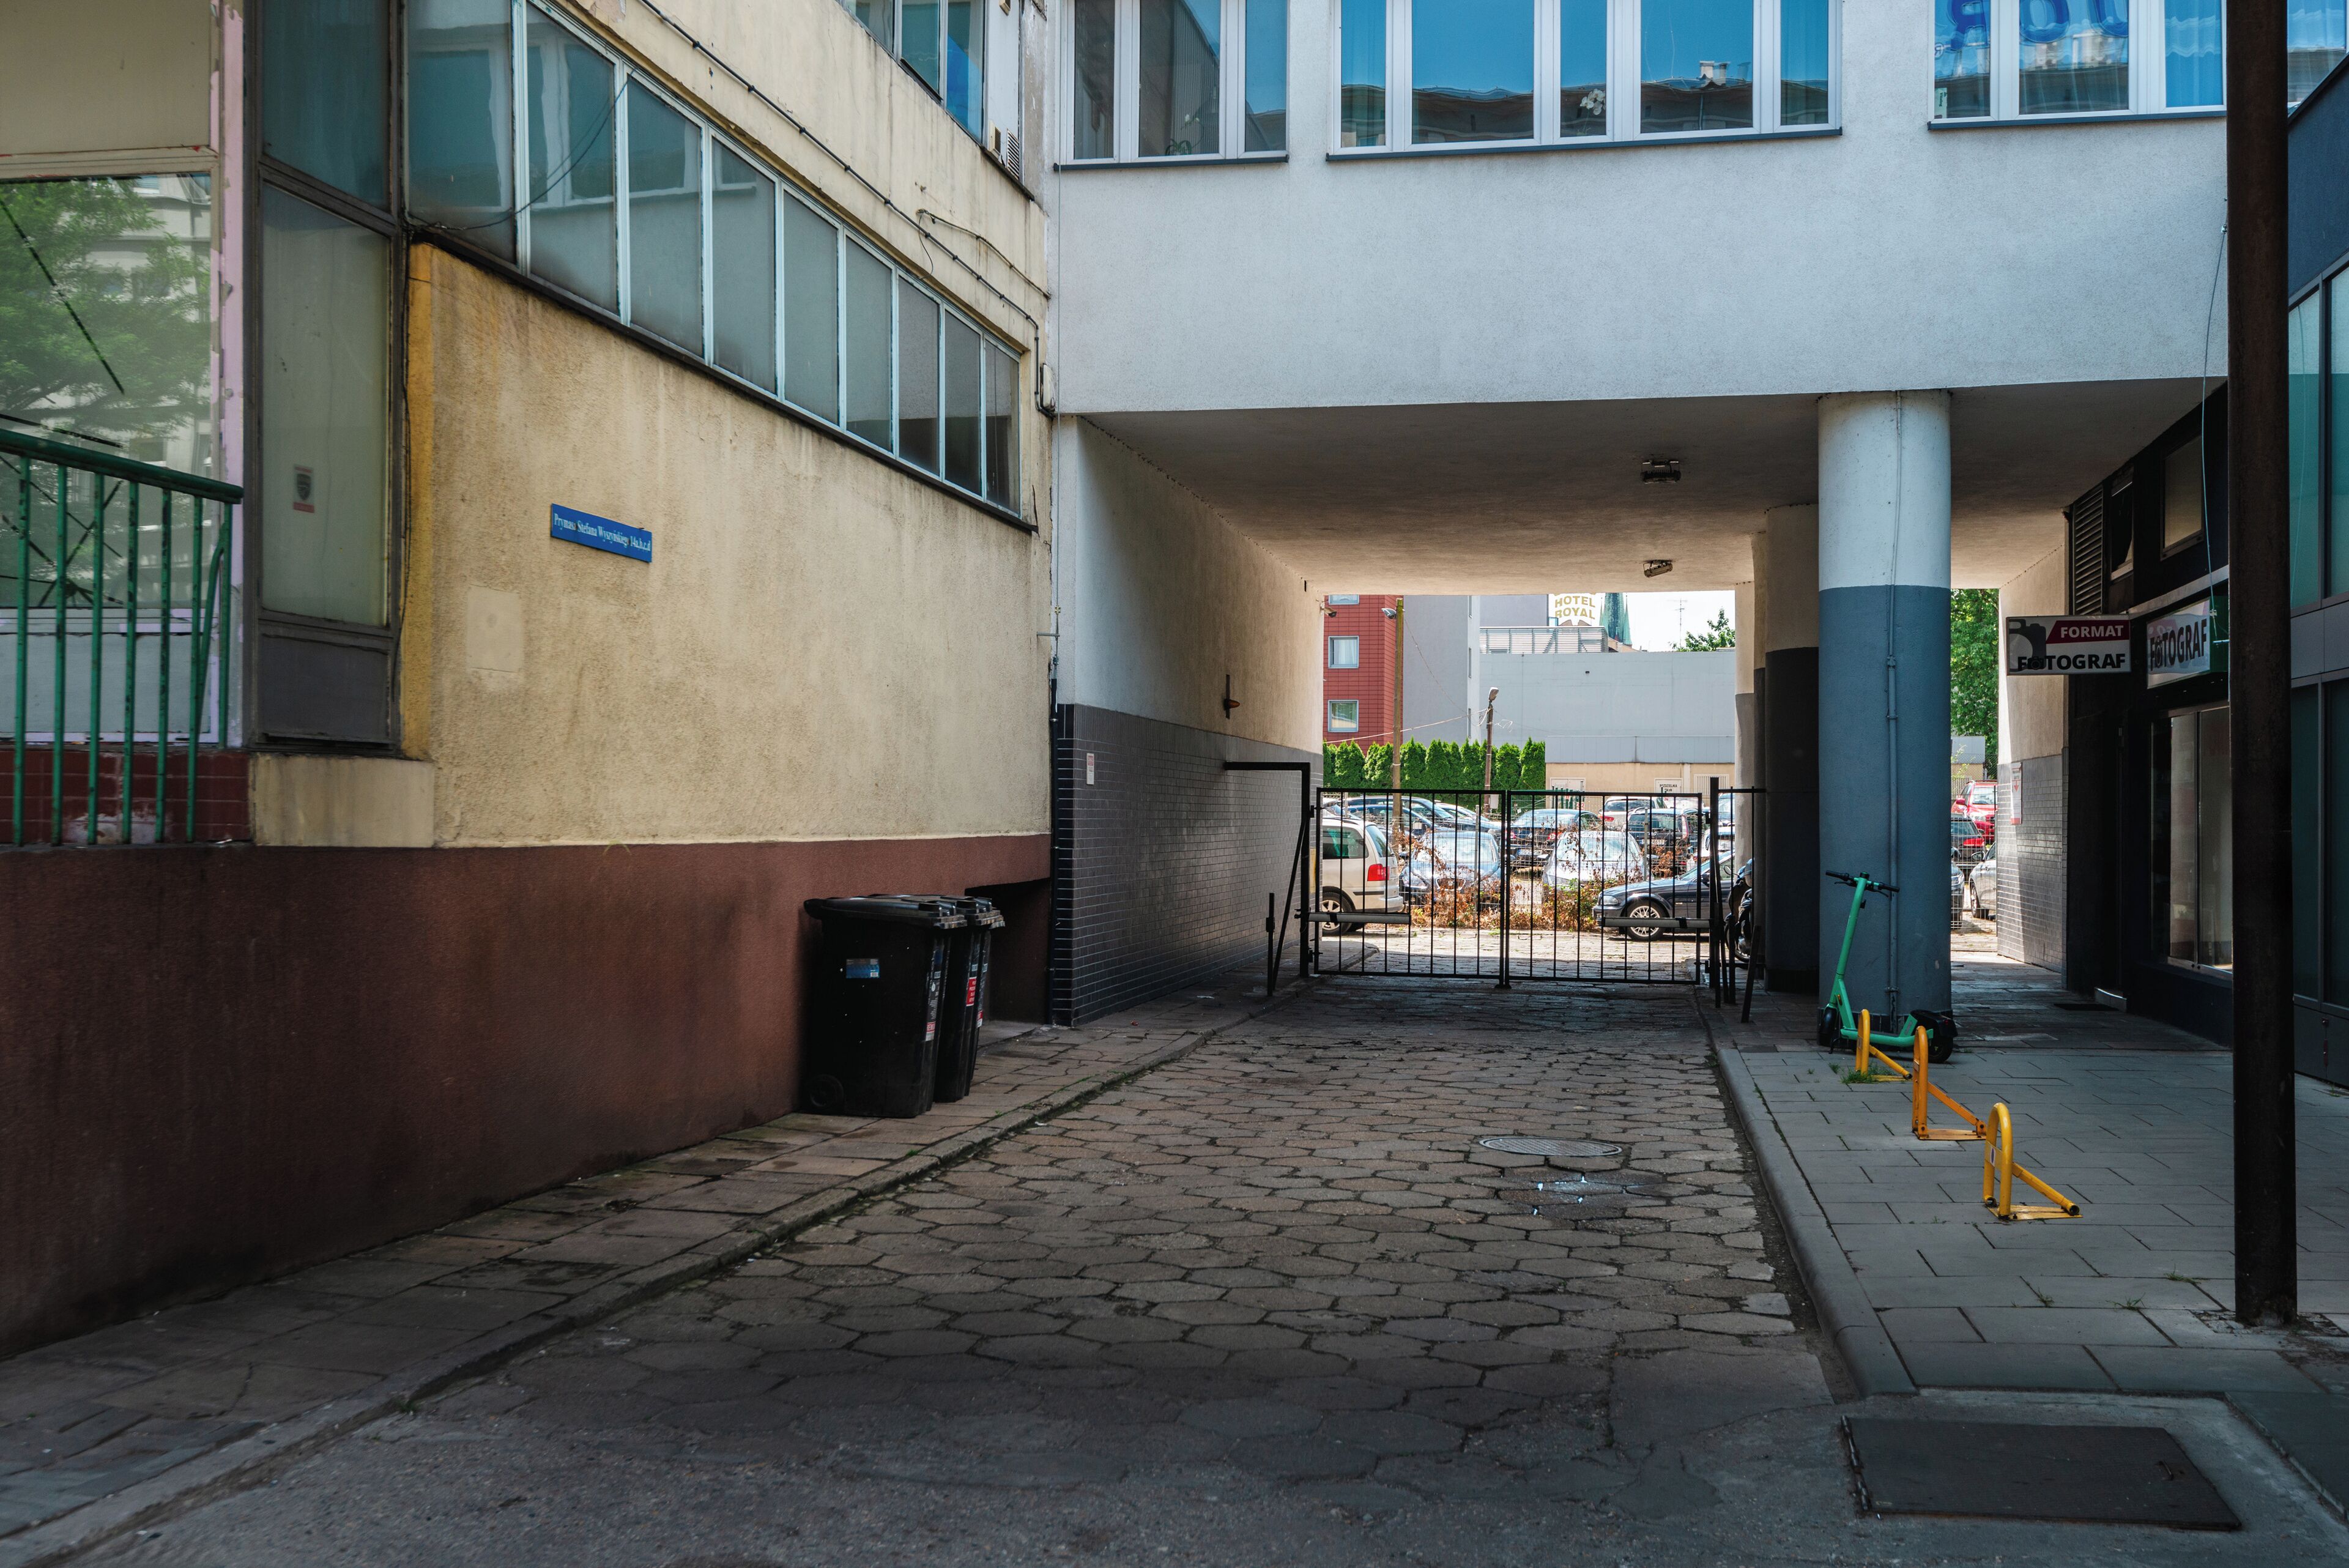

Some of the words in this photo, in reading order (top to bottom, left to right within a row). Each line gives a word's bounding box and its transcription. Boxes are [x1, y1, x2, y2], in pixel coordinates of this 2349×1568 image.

[554, 513, 576, 531] Prymasa
[577, 520, 598, 537] Stefana
[1555, 595, 1595, 608] HOTEL
[1555, 607, 1595, 619] ROYAL
[2060, 625, 2124, 639] FORMAT
